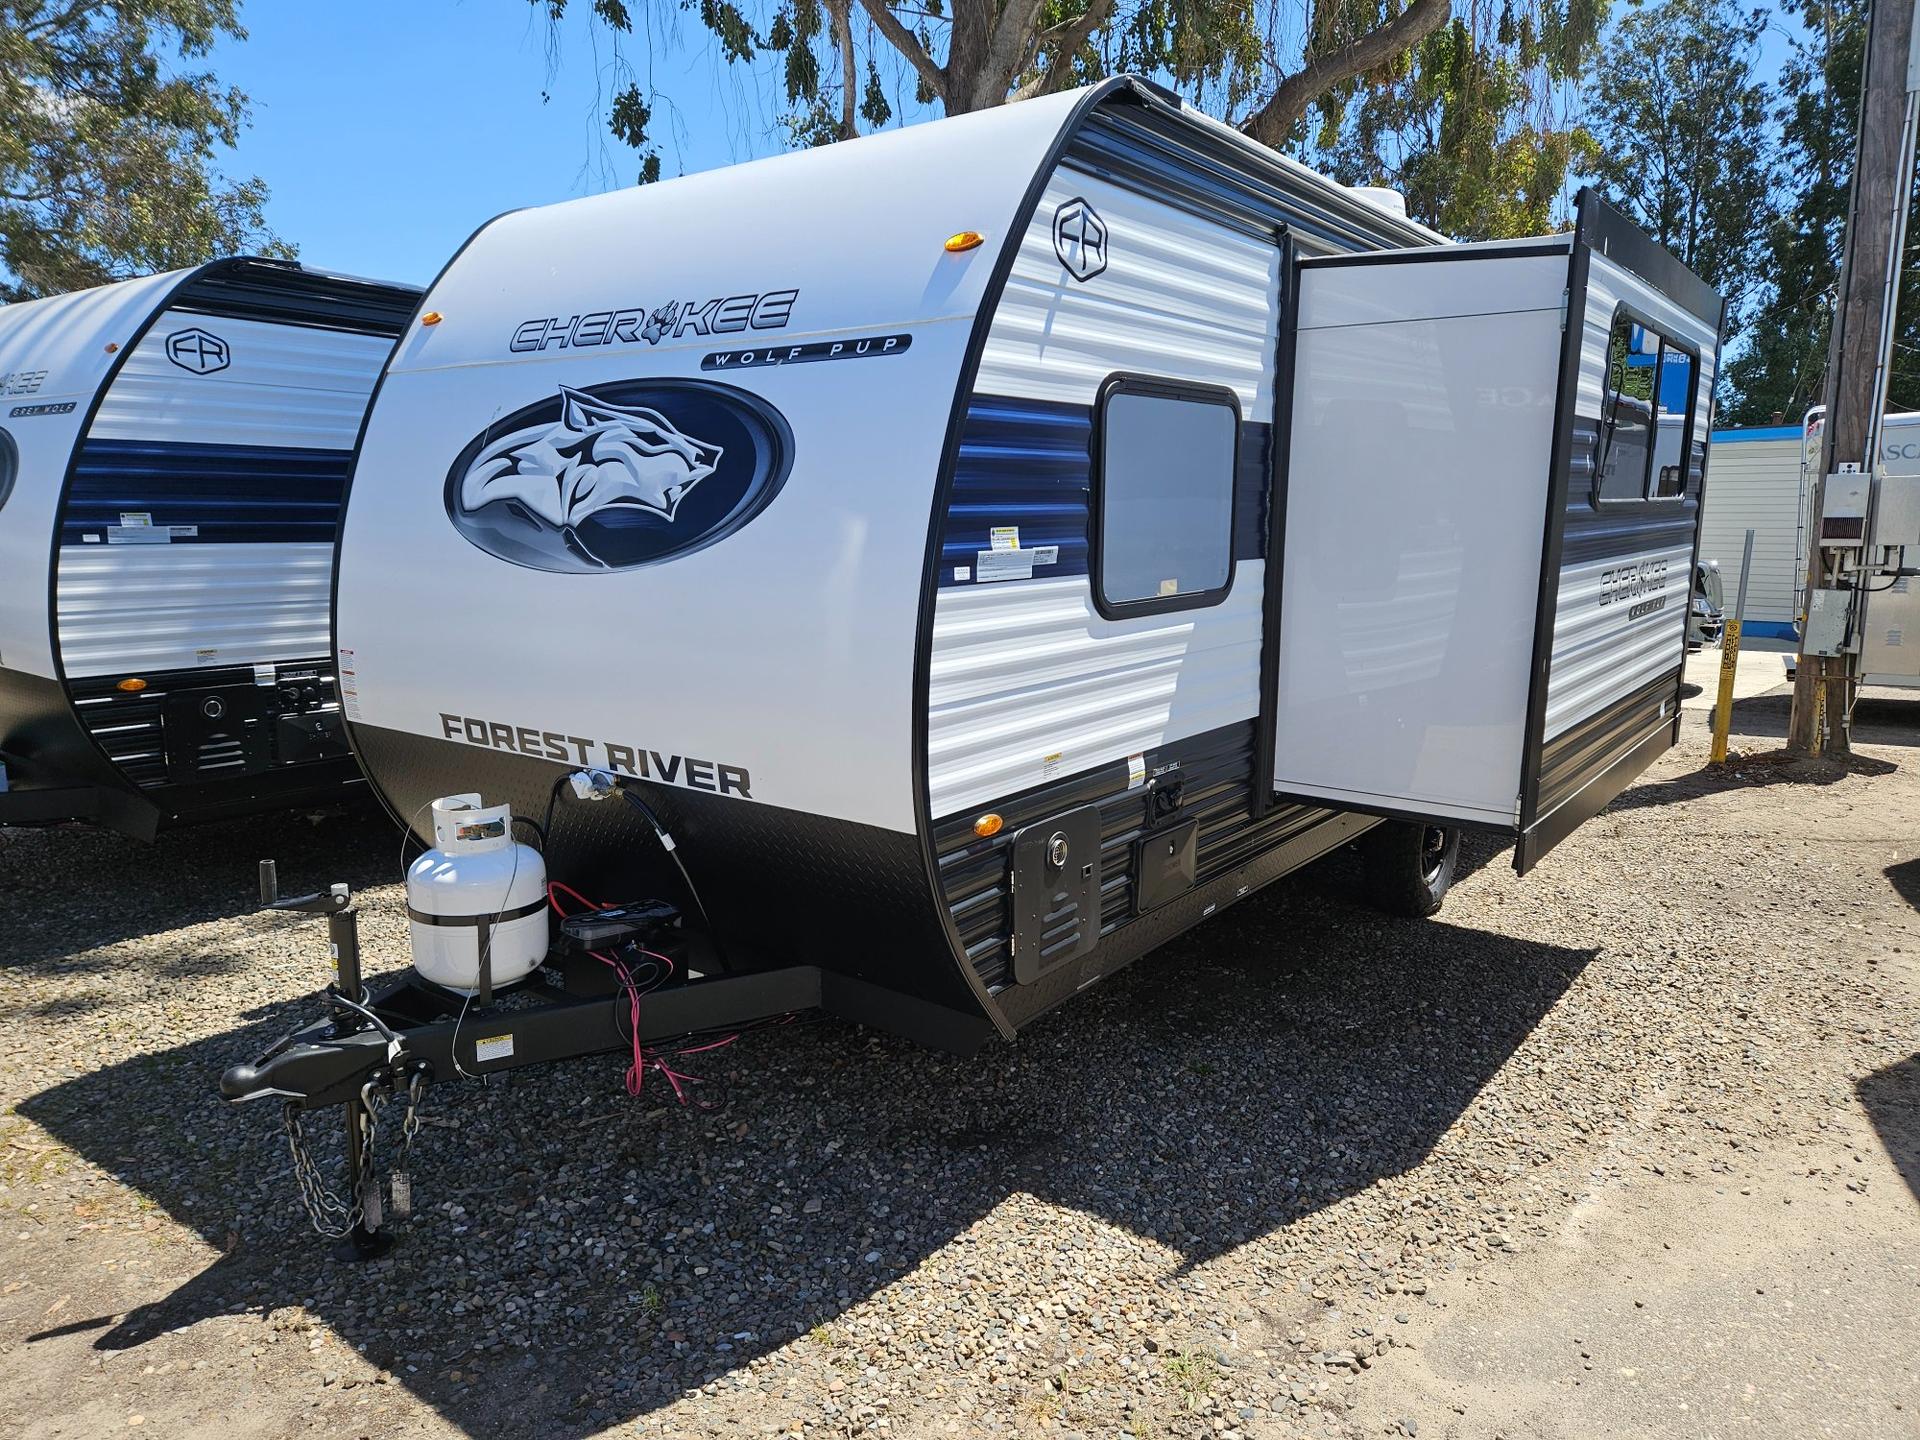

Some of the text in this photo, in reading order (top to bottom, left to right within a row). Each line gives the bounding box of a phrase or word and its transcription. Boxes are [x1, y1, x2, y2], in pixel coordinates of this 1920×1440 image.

[714, 338, 899, 366] WOLF PUP
[12, 403, 73, 417] GREY WOLF
[438, 712, 753, 799] FOREST RIVER
